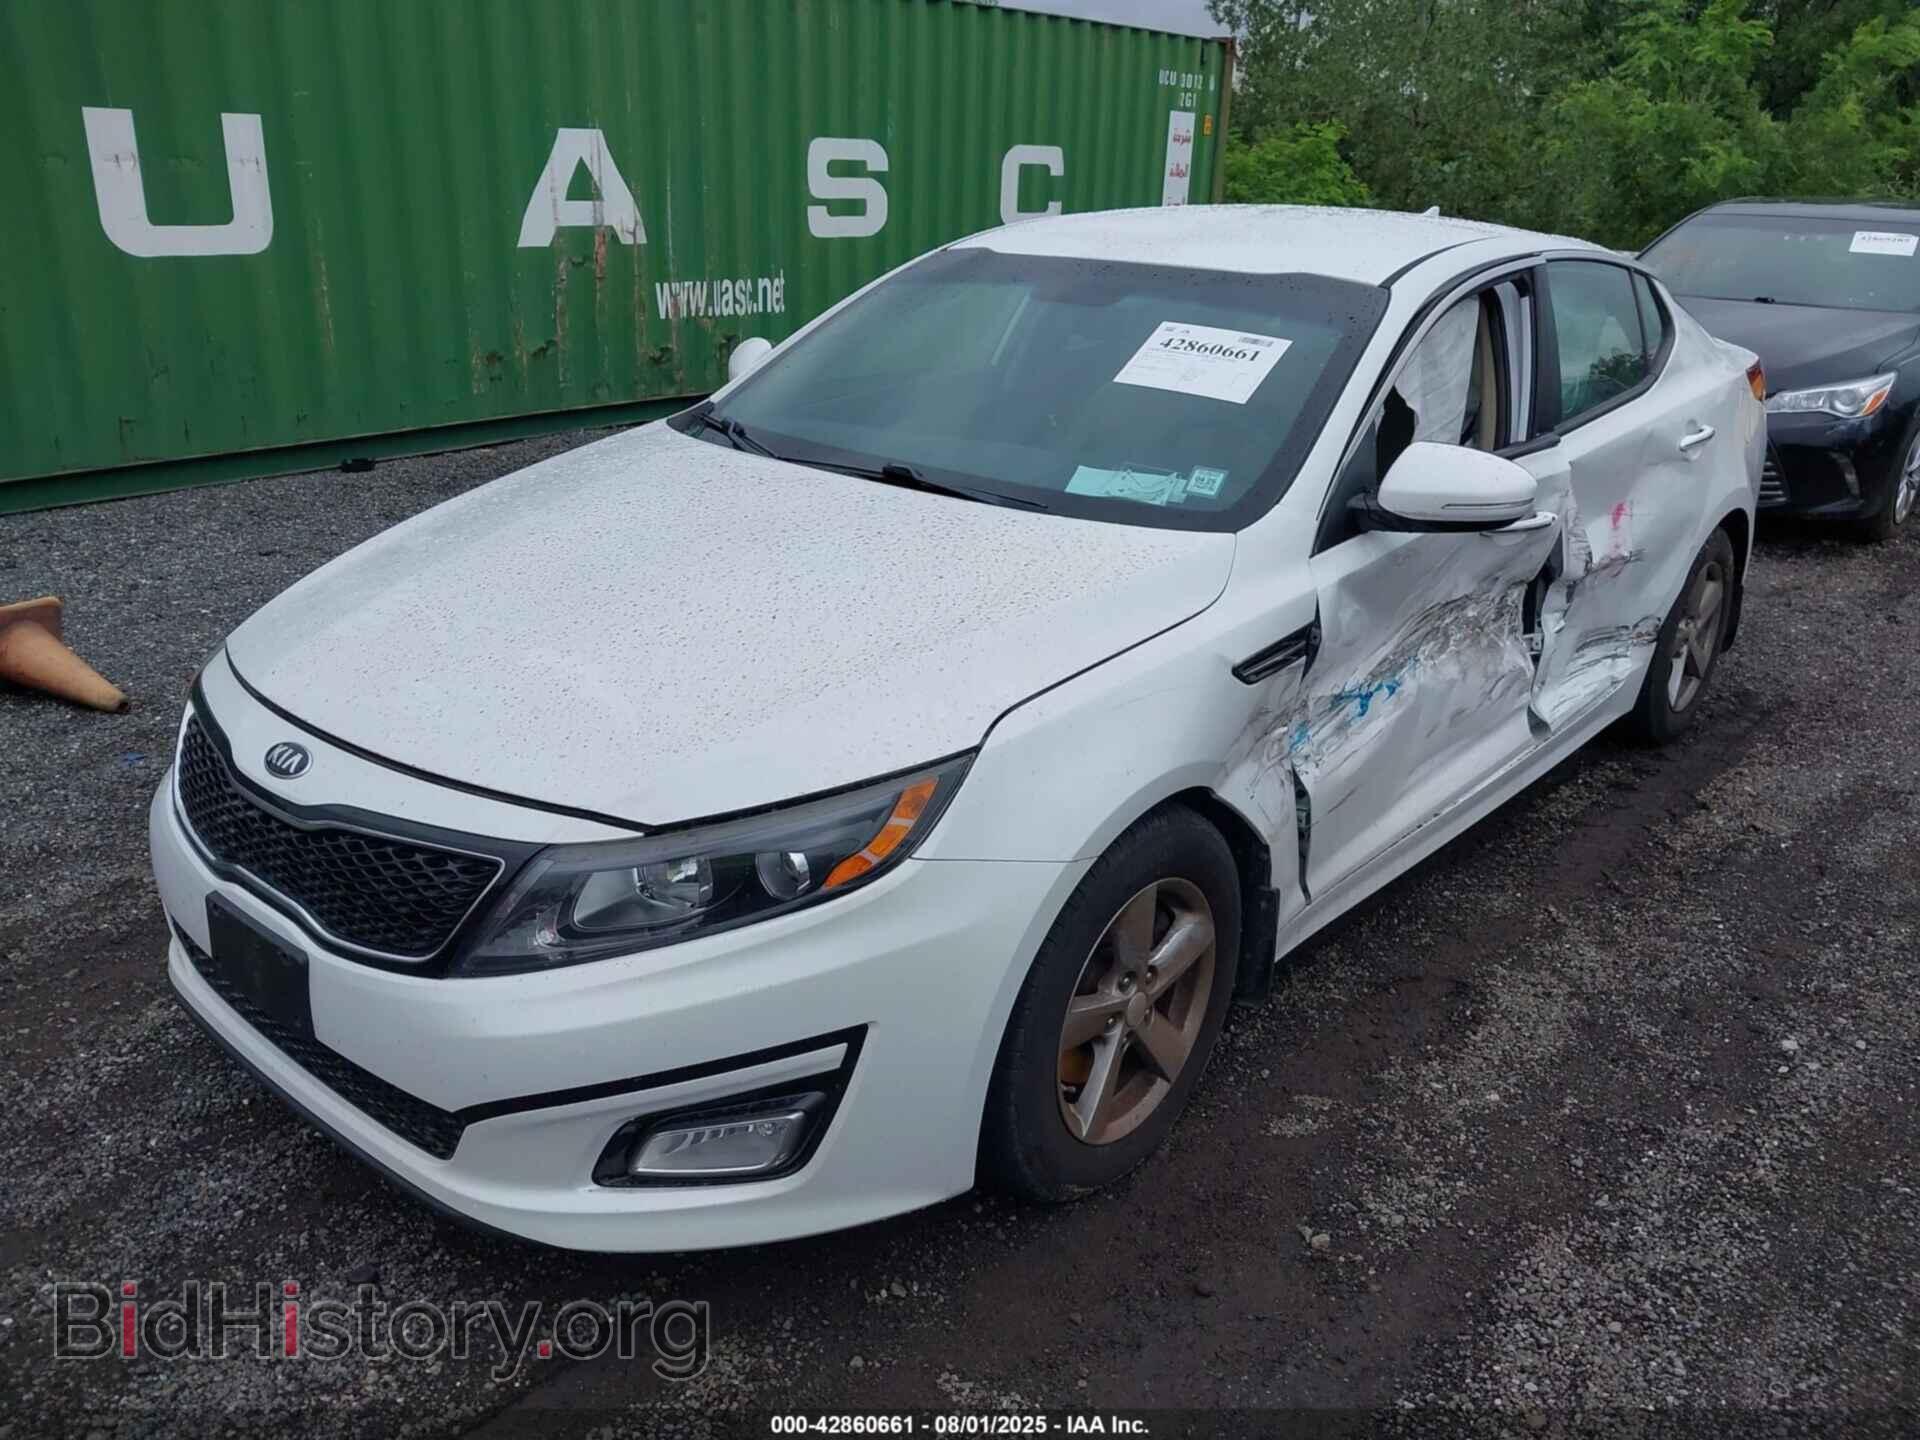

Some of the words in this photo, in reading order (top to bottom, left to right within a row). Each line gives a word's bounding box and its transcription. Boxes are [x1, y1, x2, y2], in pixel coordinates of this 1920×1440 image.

[655, 268, 785, 320] www.uasc.net
[1160, 337, 1261, 362] 42860661
[267, 744, 303, 774] KIA
